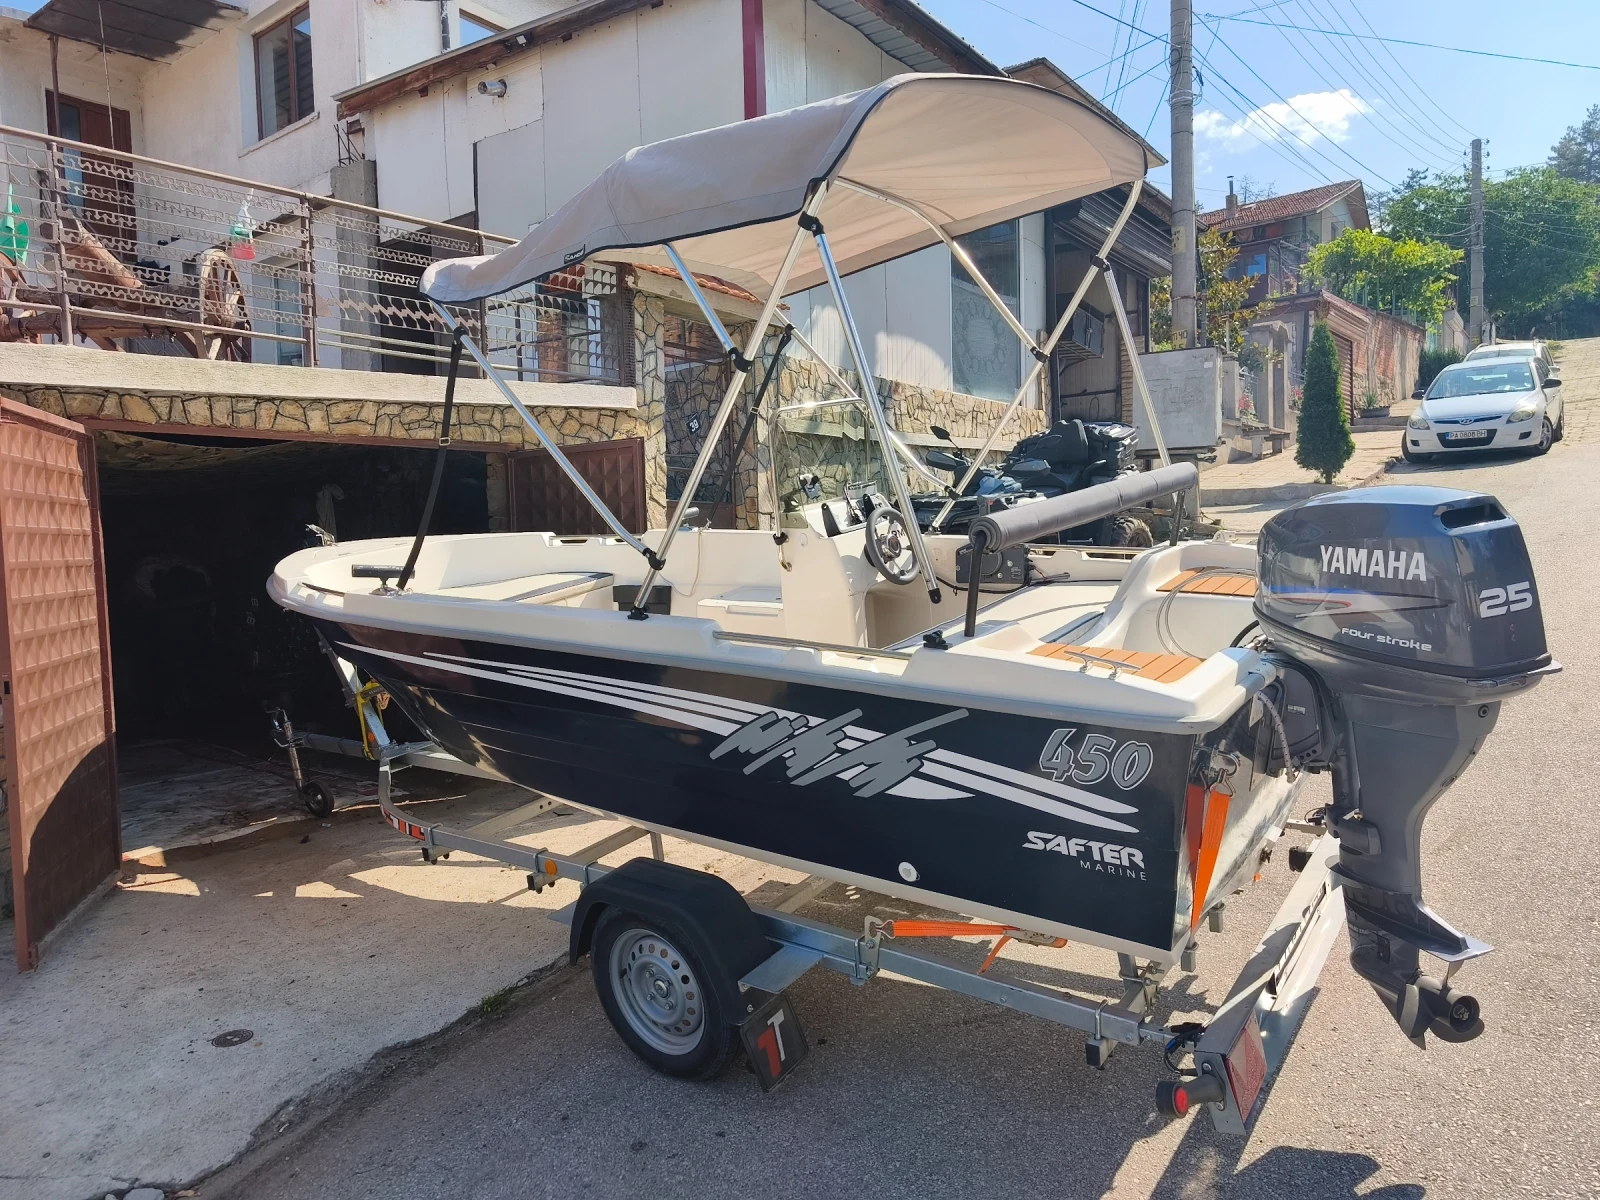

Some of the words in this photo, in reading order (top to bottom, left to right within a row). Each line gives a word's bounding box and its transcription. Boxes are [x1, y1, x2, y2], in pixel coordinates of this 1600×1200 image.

[689, 419, 699, 432] 39
[1320, 545, 1427, 582] YAMAHA
[1479, 581, 1533, 619] 25
[1039, 728, 1153, 791] 450
[1022, 830, 1145, 869] SAFTER
[1080, 860, 1147, 881] MARINE
